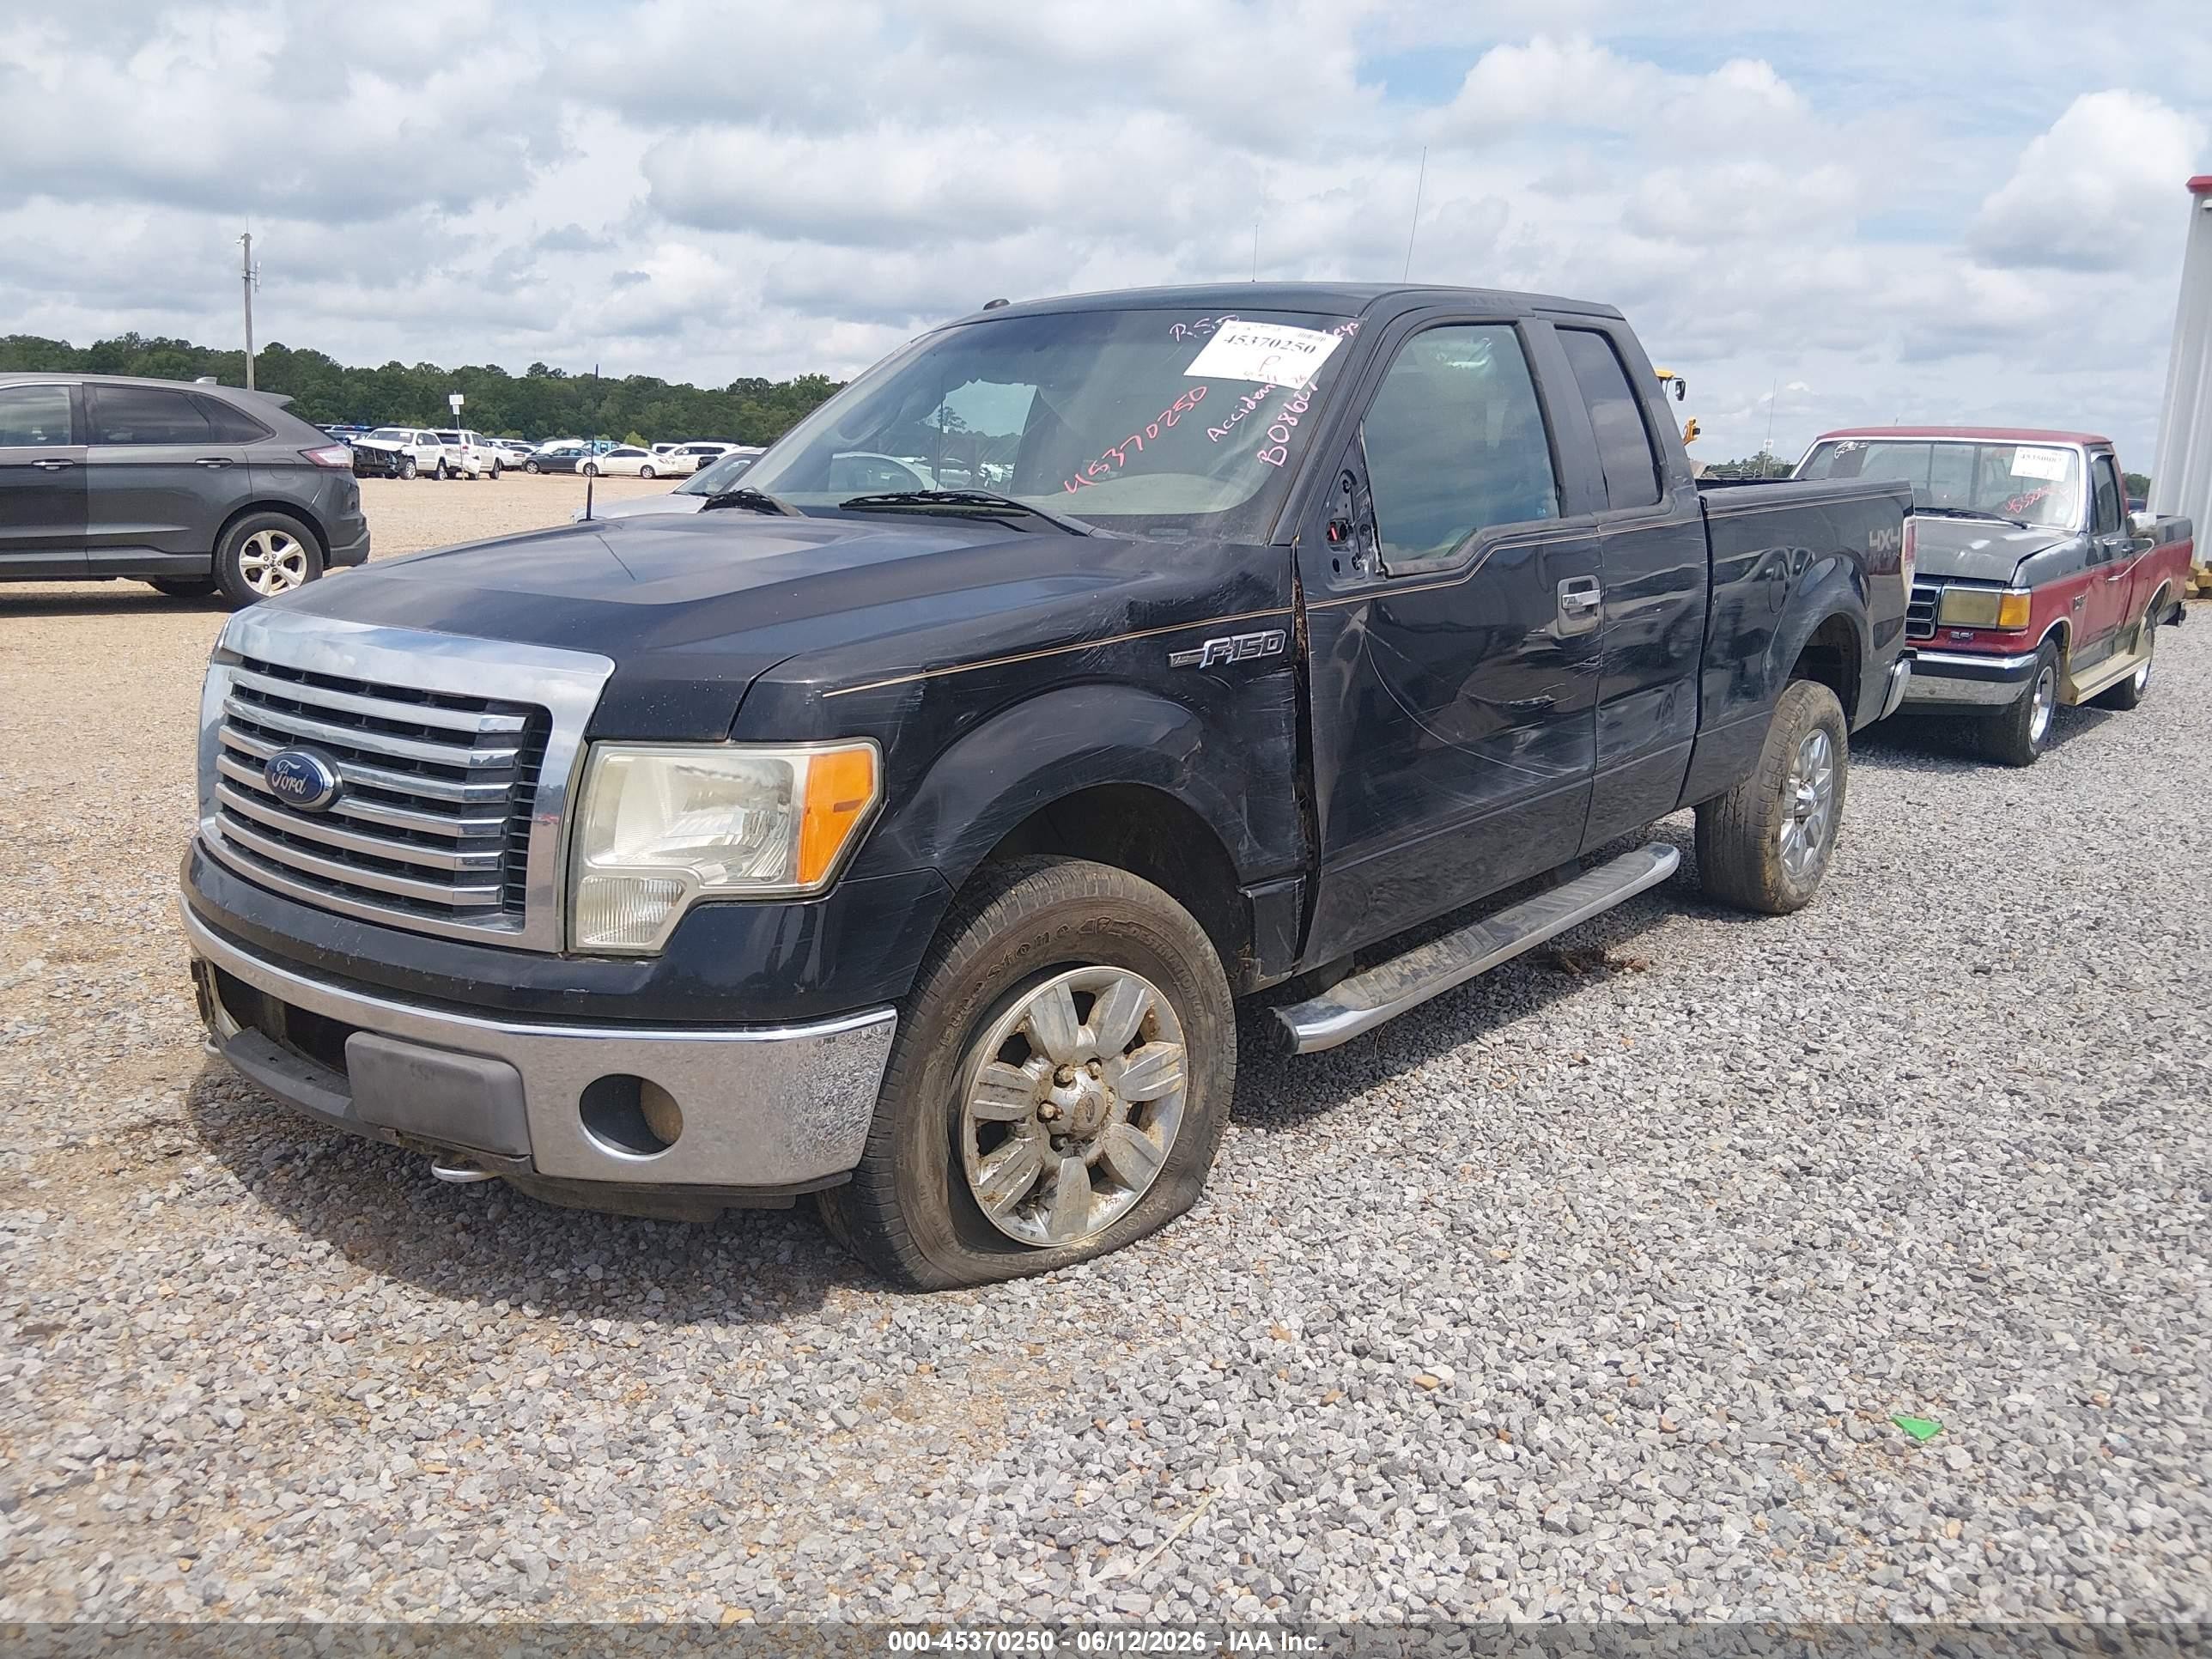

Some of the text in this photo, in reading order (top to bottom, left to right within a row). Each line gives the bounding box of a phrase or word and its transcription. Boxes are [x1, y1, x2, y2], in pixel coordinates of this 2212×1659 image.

[1223, 333, 1317, 355] 45370250
[1322, 322, 1359, 337] eys
[1207, 384, 1277, 442] Acciden
[1064, 386, 1207, 494] 45370250
[271, 759, 309, 795] Ford
